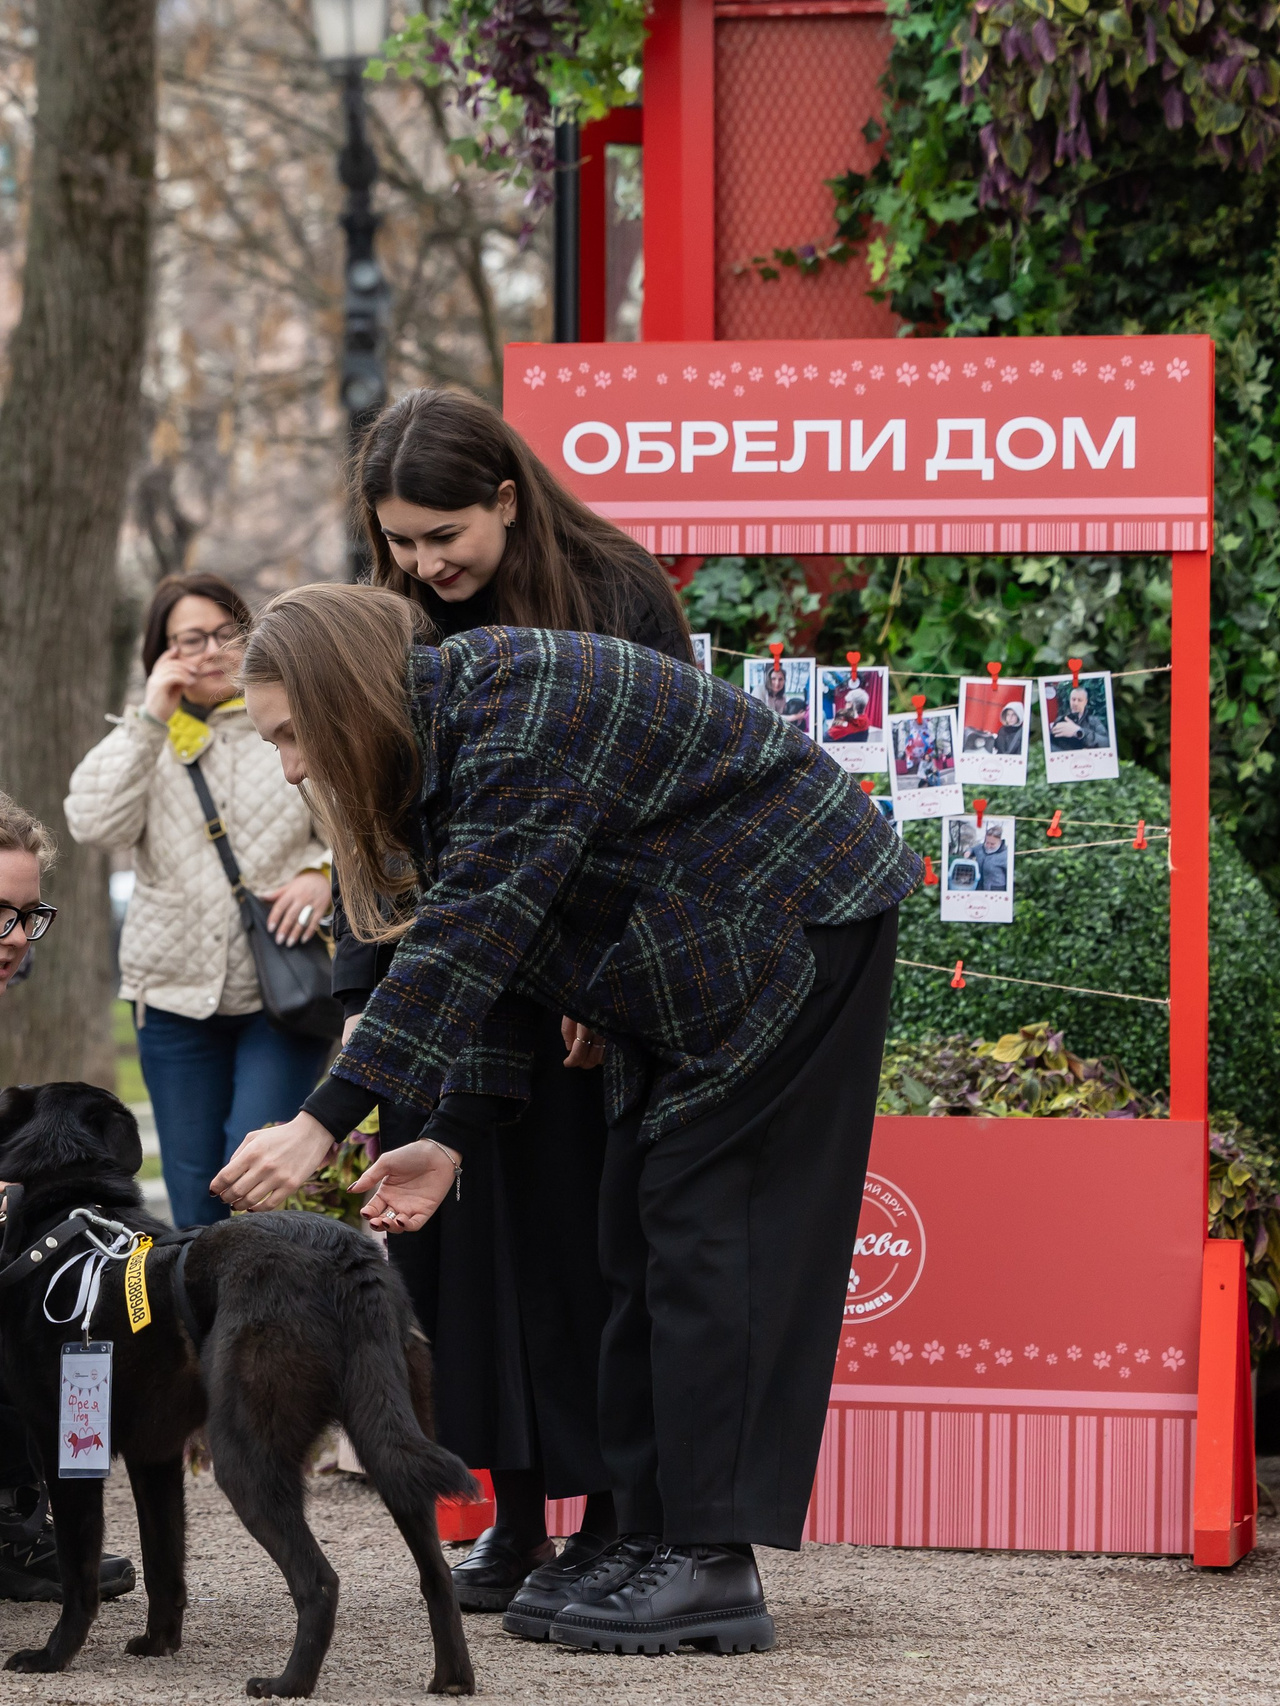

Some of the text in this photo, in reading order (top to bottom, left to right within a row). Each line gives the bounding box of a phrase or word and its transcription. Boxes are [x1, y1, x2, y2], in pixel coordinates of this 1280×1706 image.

[561, 416, 1136, 481] ОБРЕЛИ ДОМ
[880, 1192, 908, 1217] ДРУГ
